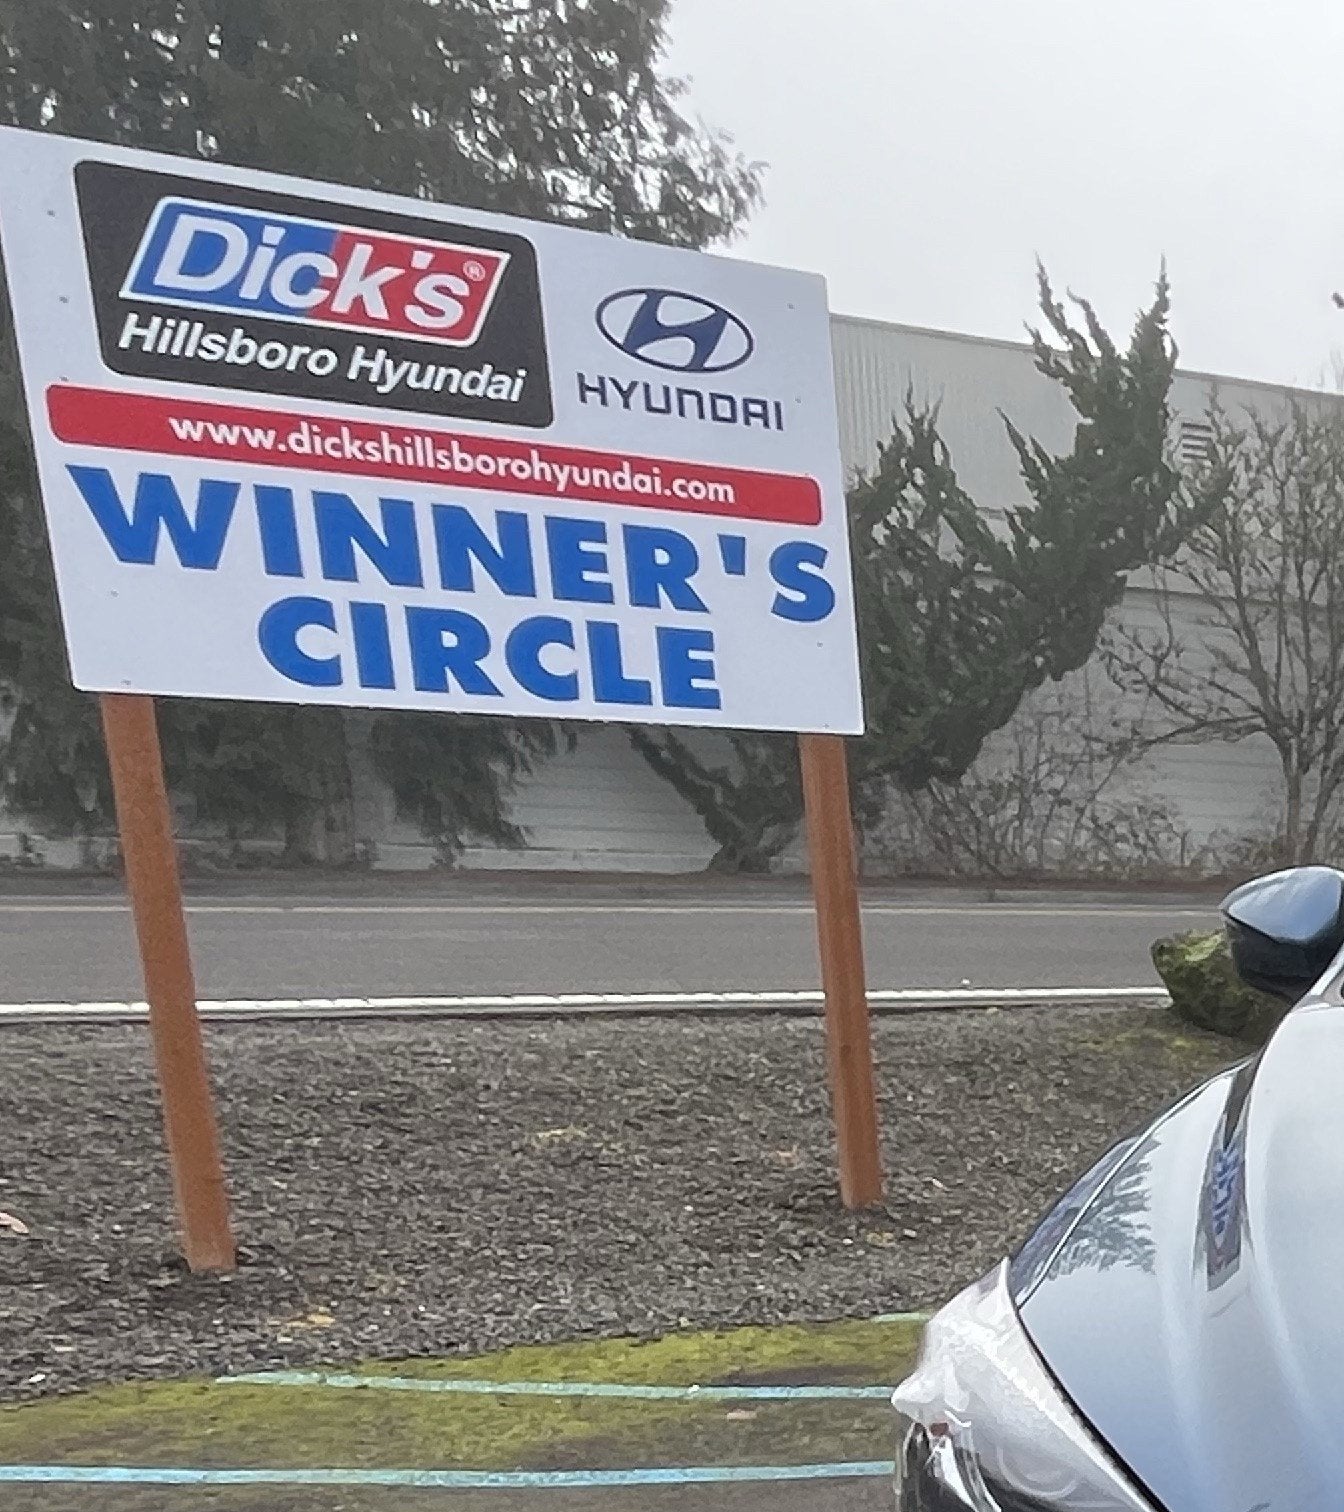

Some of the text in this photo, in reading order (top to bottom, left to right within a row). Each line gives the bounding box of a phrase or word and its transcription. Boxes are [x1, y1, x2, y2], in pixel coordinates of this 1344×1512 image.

[152, 216, 472, 330] Dick's
[118, 312, 528, 404] Hillsboro Hyundai
[576, 372, 784, 431] HYUNDAI
[169, 412, 736, 505] www.dickshillsborohyundai.com
[66, 465, 836, 623] WINNER'S
[257, 596, 723, 711] CIRCLE
